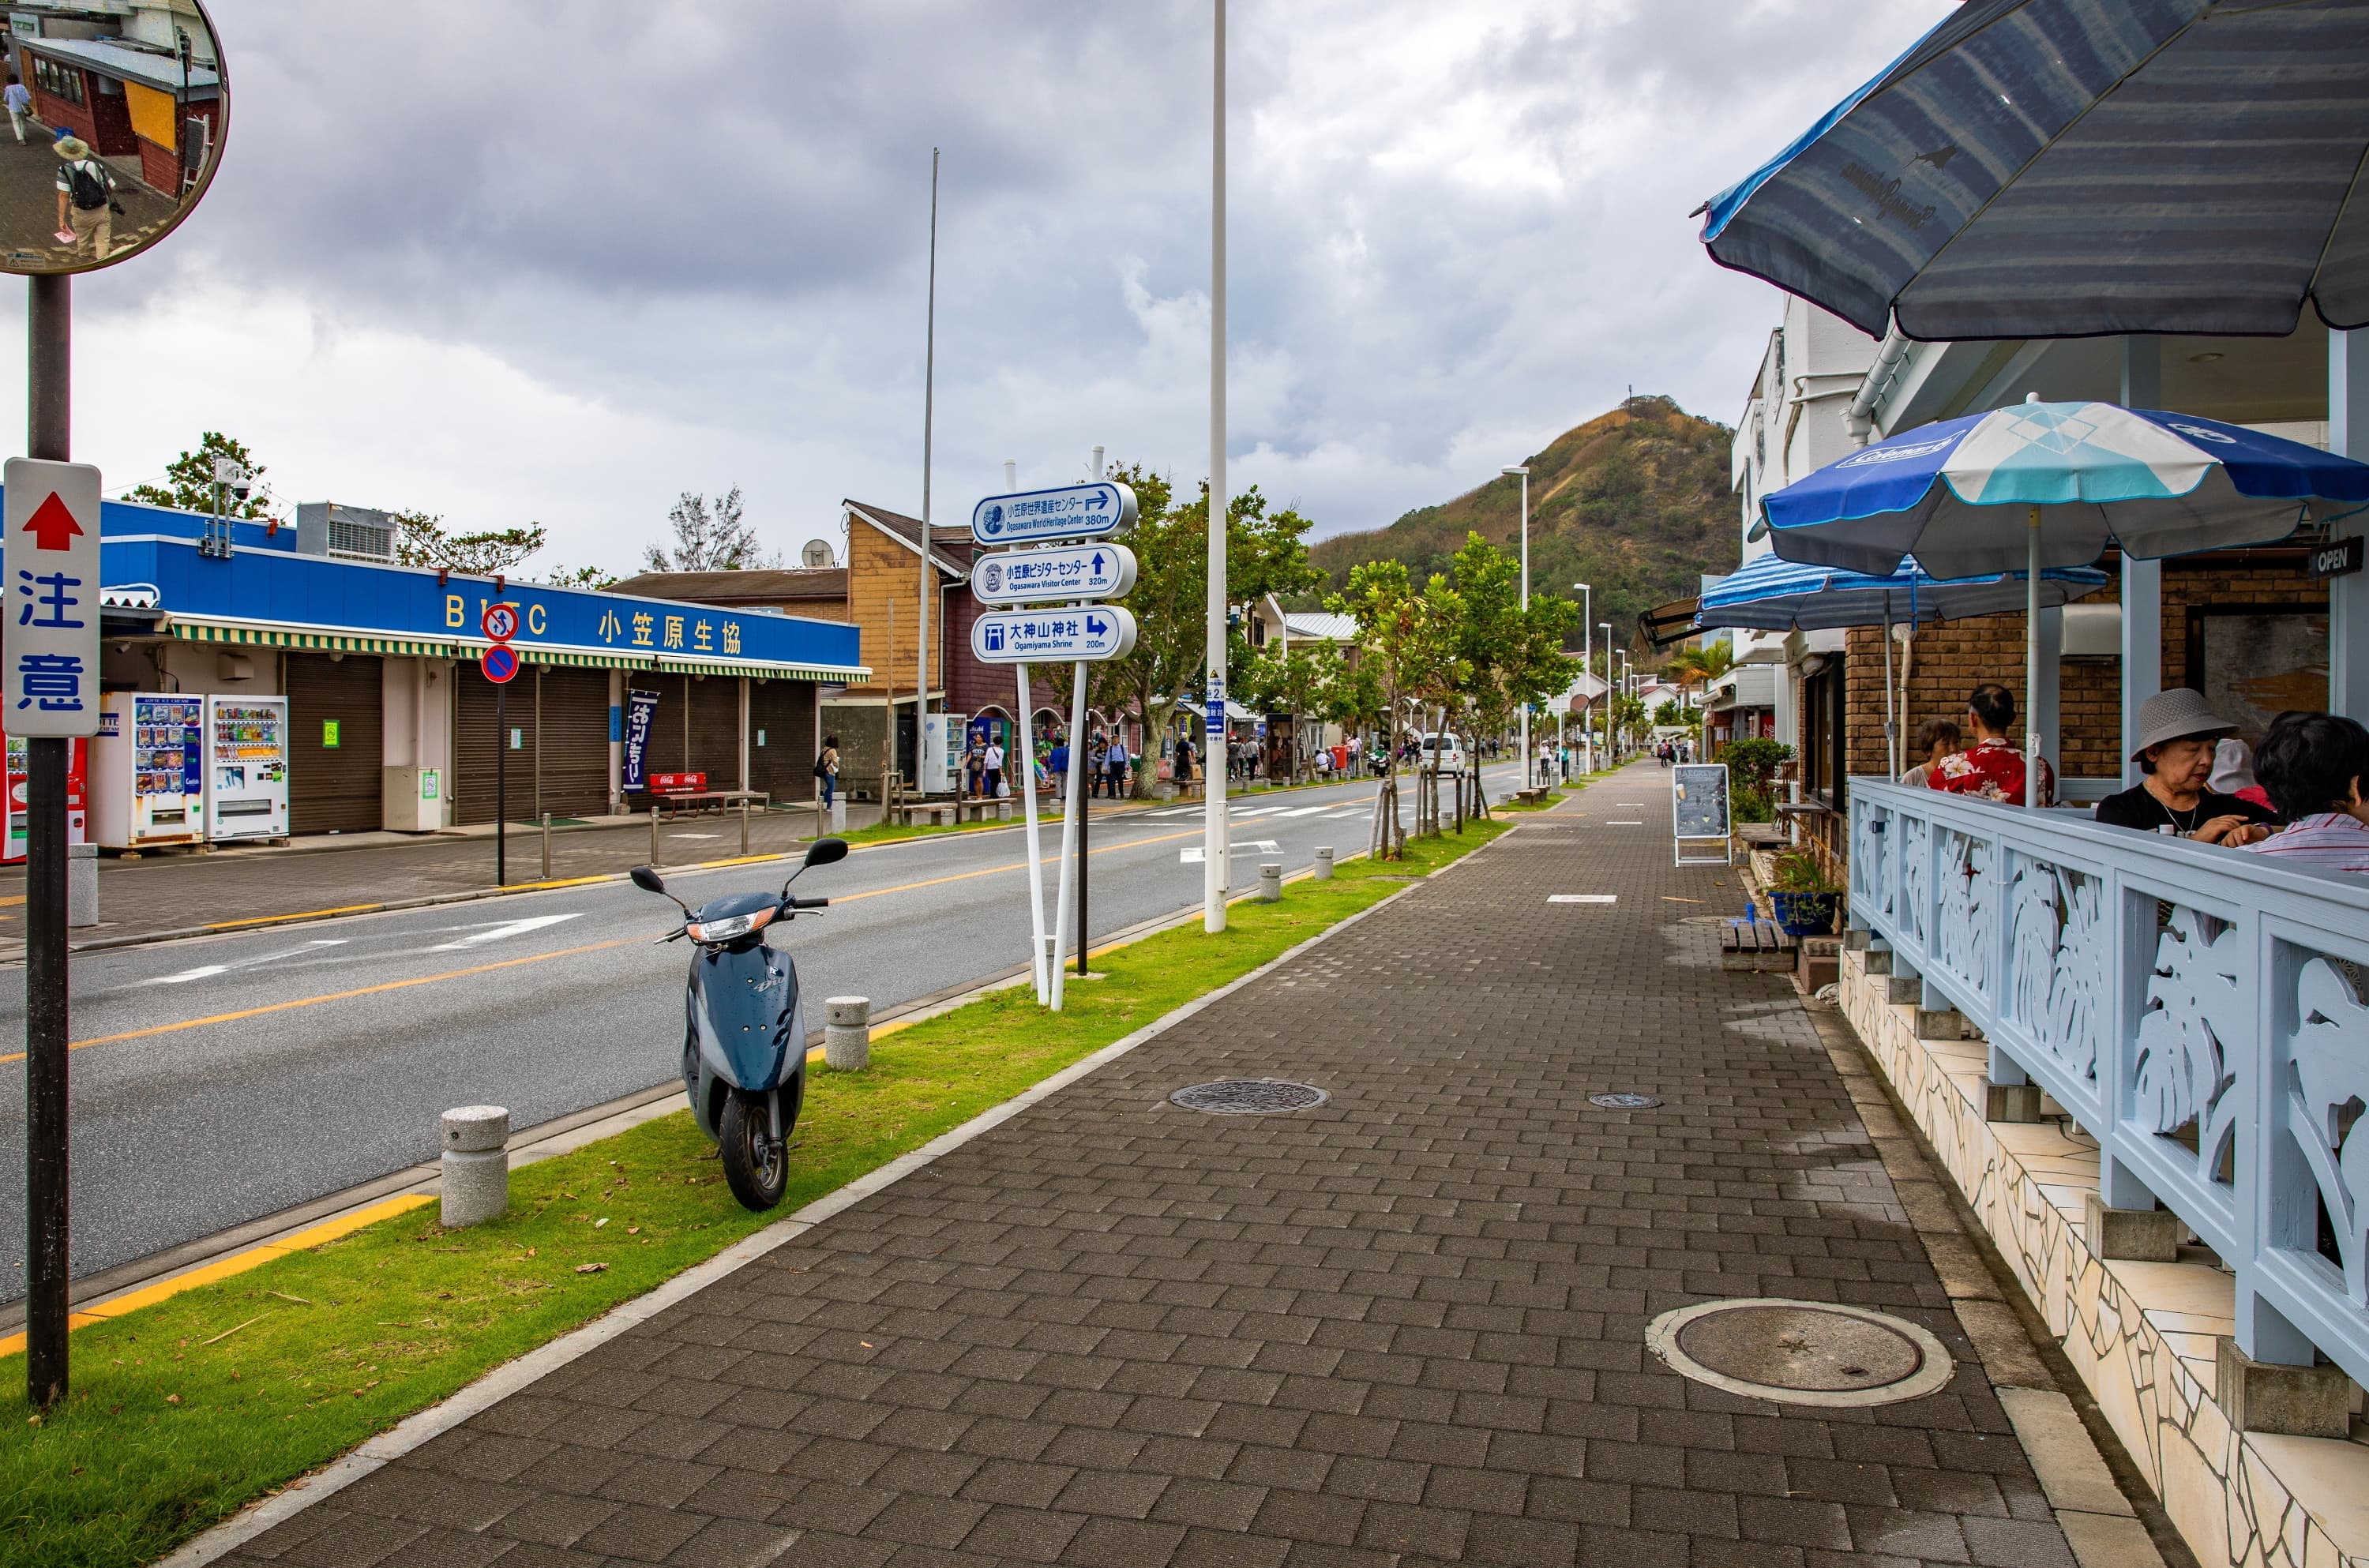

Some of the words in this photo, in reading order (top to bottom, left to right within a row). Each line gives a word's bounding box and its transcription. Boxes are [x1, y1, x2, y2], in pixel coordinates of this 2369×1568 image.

[1007, 497, 1083, 518] 小笠原世界遺産センター
[1006, 520, 1032, 533] Ogasawara
[1032, 517, 1046, 529] World
[1046, 516, 1067, 528] Heritage
[1067, 515, 1083, 525] Center
[1085, 514, 1109, 526] 380m
[2318, 547, 2348, 572] OPEN
[1006, 560, 1087, 580] 小笠原ビジターセンター
[1009, 582, 1040, 592] Ogasawara
[1088, 577, 1108, 586] 320m
[599, 610, 741, 655] 小笠原生協
[1010, 620, 1079, 640] 大神山神社
[18, 570, 84, 711] 注意
[1015, 641, 1051, 651] Ogamiyama
[1053, 640, 1073, 648] Shrine
[1214, 688, 1220, 699] 2
